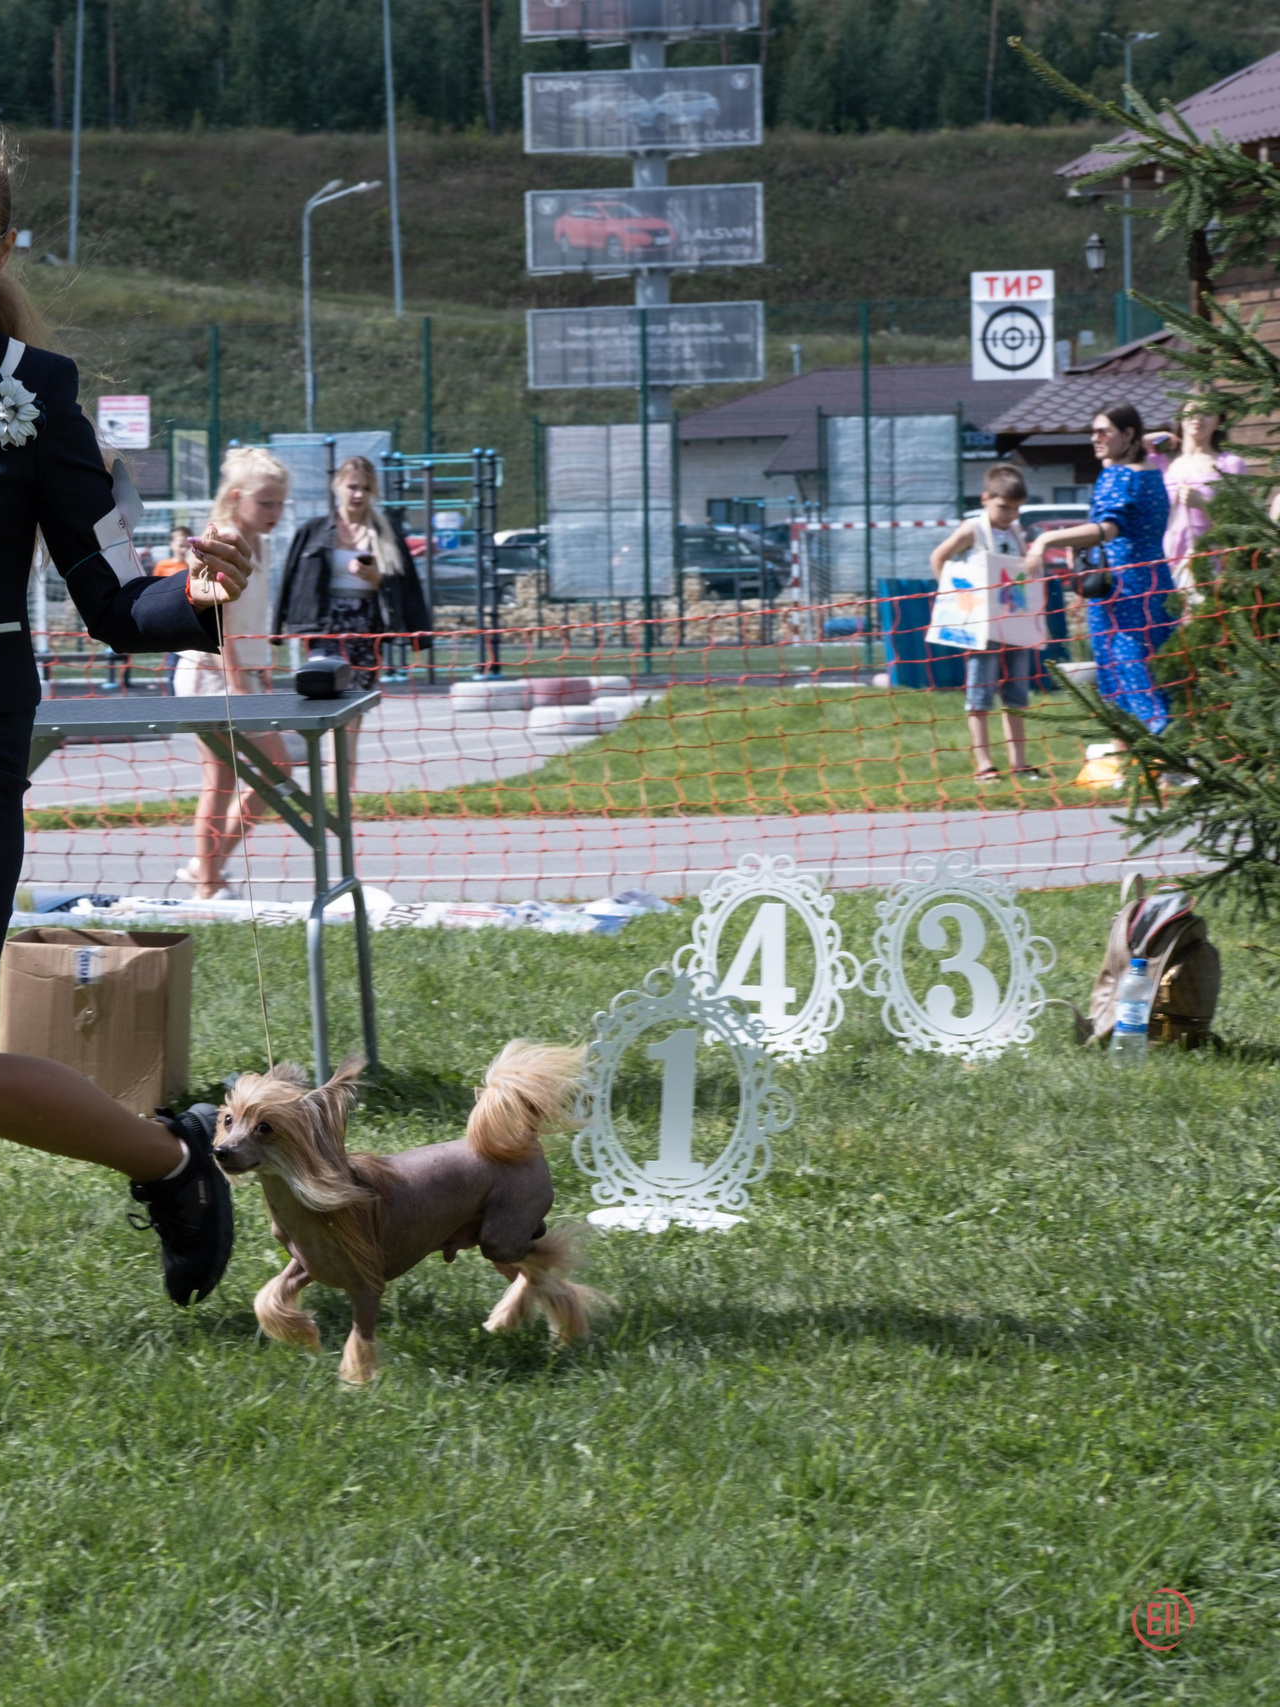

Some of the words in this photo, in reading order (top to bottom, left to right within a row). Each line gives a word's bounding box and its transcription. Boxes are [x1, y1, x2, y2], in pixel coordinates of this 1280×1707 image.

[984, 275, 1043, 298] ТИР
[718, 902, 798, 1030] 4
[920, 902, 1001, 1035] 3
[644, 1028, 706, 1180] 1
